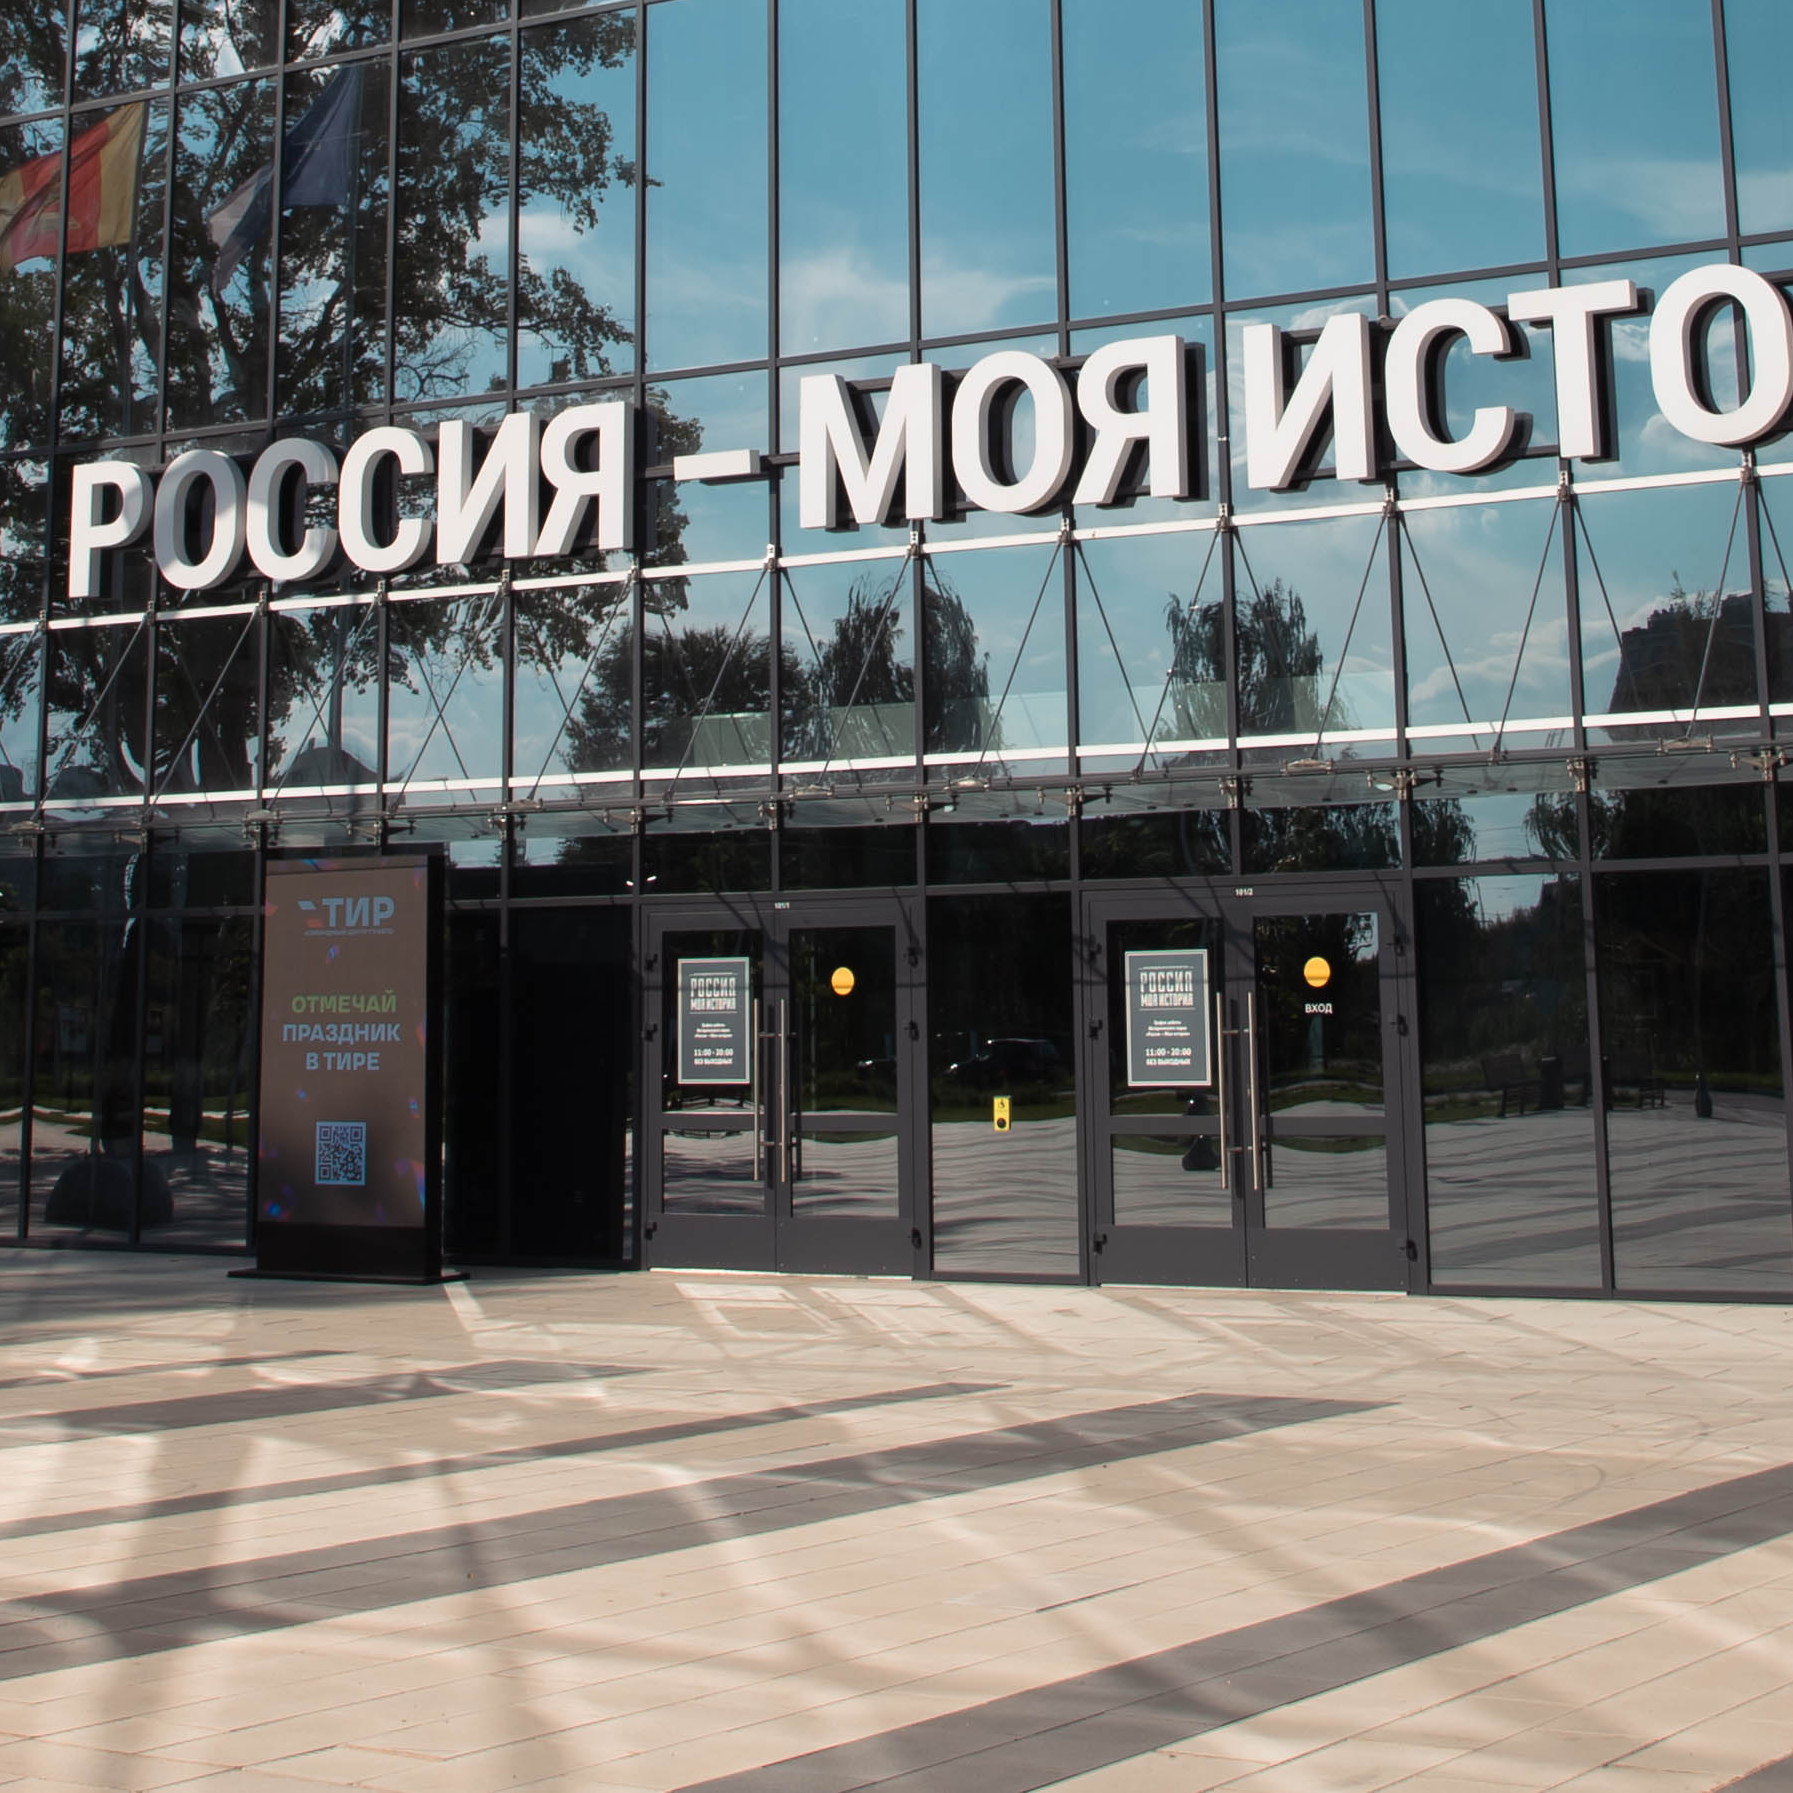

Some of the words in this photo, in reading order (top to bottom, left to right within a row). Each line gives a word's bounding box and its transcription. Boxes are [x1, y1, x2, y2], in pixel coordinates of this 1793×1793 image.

[68, 401, 634, 599] РОССИЯ
[799, 334, 1188, 530] МОЯ
[321, 896, 395, 927] ТИР
[690, 977, 736, 997] РОССИЯ
[1140, 970, 1193, 993] РОССИЯ
[292, 989, 397, 1014] ОТМЕЧАЙ
[1305, 1003, 1333, 1014] ВХОД
[282, 1023, 401, 1046] ПРАЗДНИК
[306, 1052, 318, 1071] В
[323, 1051, 380, 1071] ТИРЕ
[1146, 1048, 1166, 1057] 11:00
[1171, 1047, 1191, 1056] 20:00
